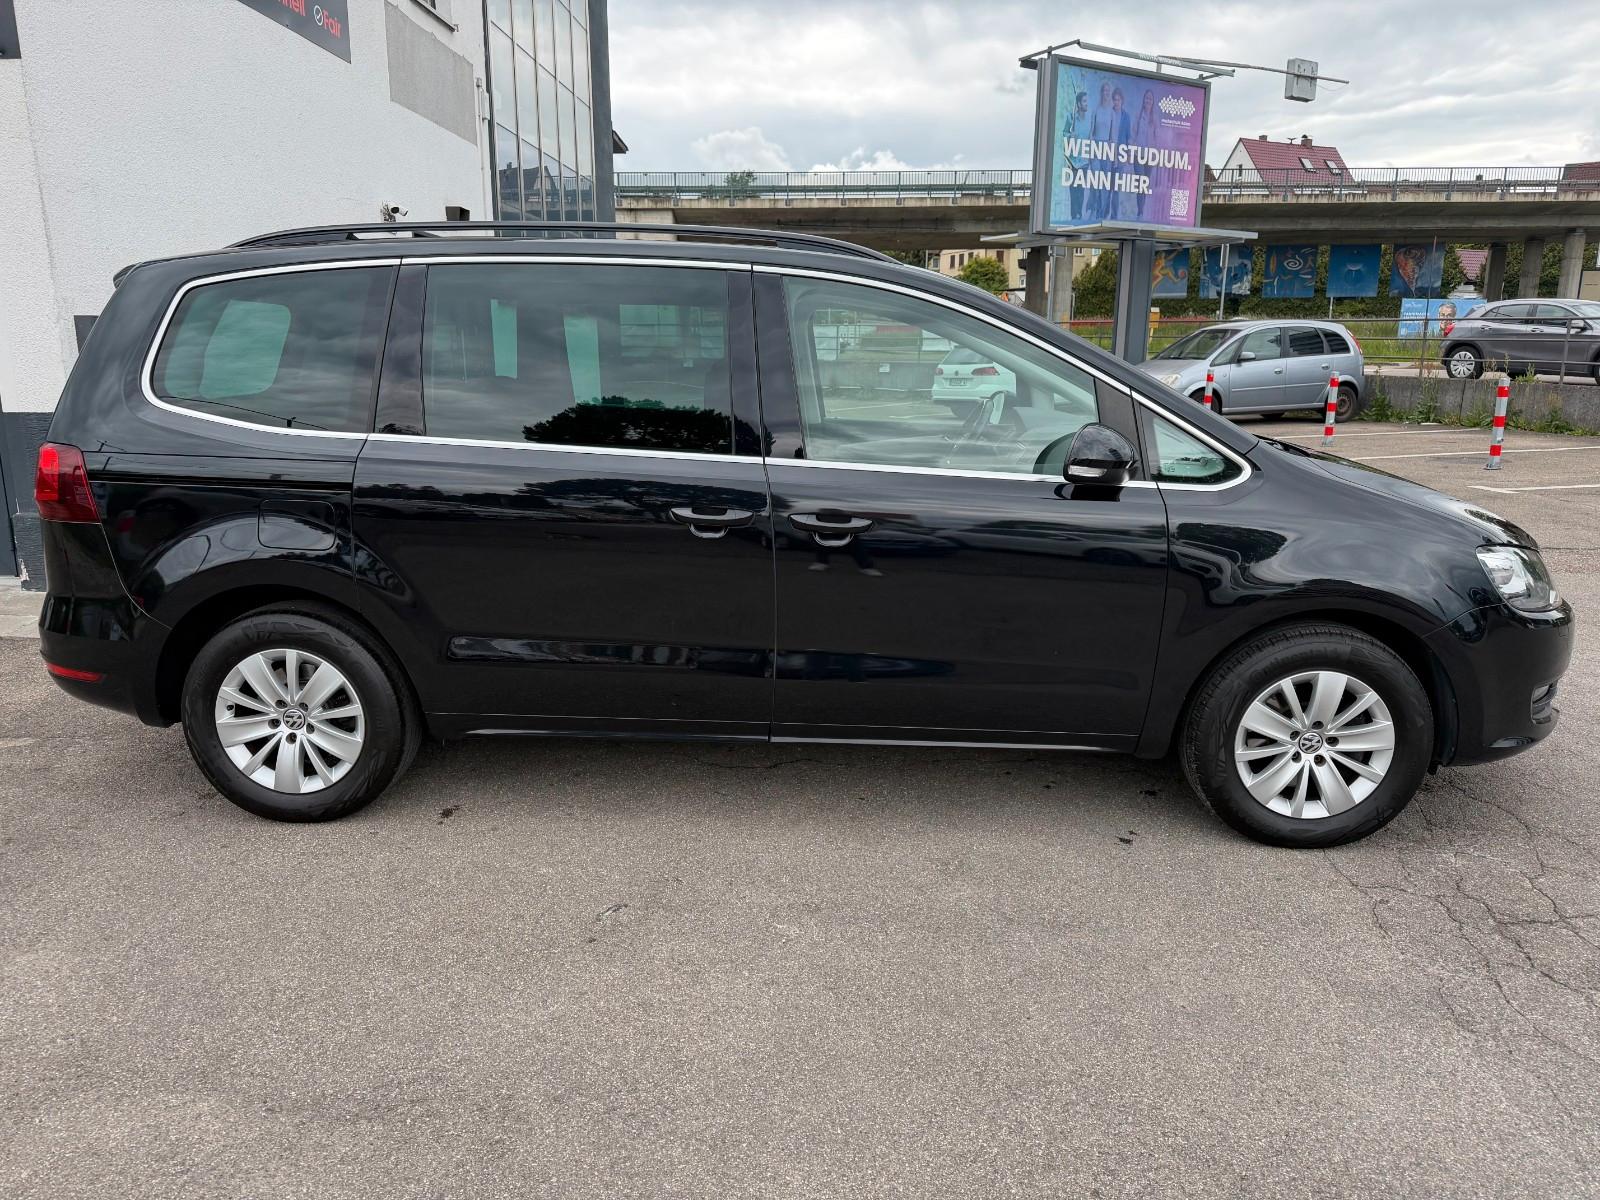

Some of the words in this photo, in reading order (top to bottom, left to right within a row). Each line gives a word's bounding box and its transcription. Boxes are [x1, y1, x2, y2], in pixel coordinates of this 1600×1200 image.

[323, 9, 342, 39] Fair
[1063, 137, 1115, 162] WENN
[1118, 143, 1192, 171] STUDIUM.
[1061, 167, 1112, 191] DANN
[1114, 172, 1153, 195] HIER.
